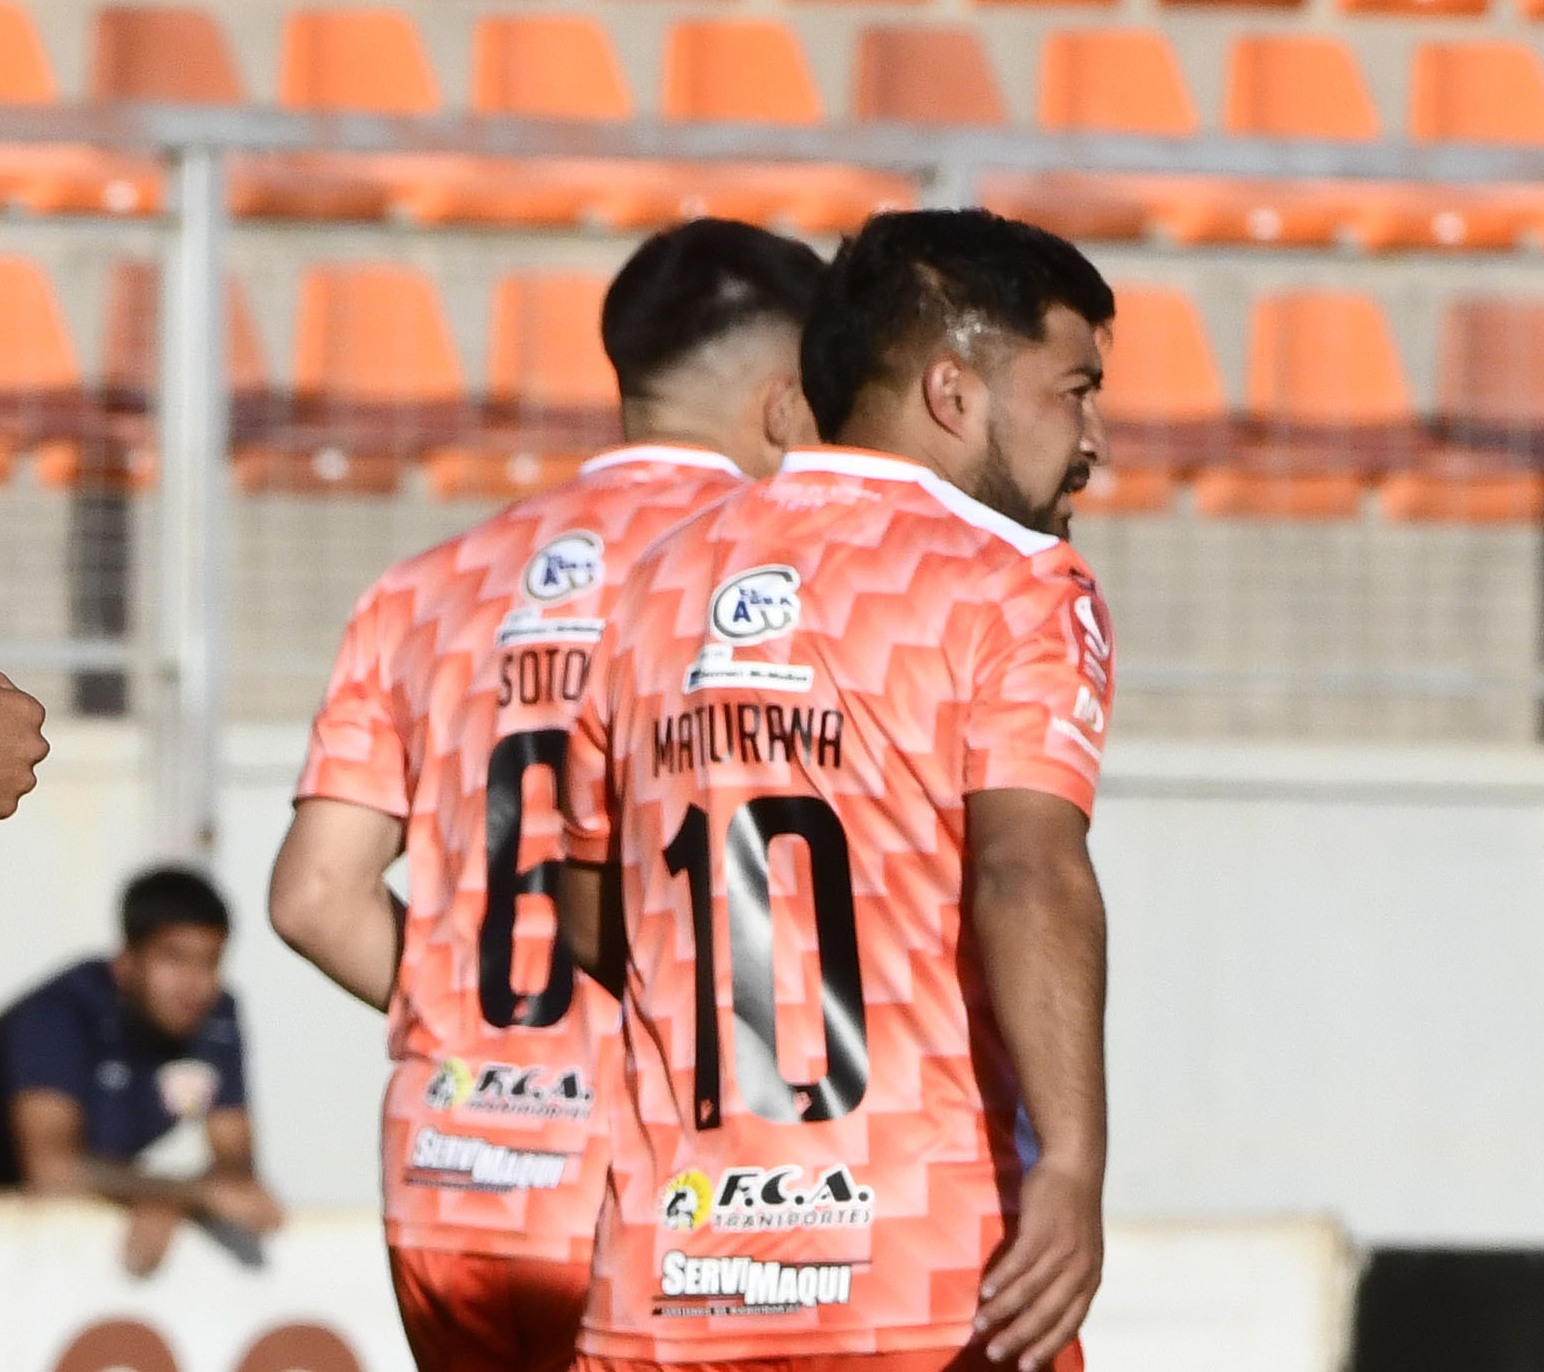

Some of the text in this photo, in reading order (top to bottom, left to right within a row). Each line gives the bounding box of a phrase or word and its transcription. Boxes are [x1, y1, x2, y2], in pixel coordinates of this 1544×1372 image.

[498, 647, 592, 707] SOTO
[653, 700, 844, 779] MATURANA
[663, 794, 870, 1131] 10
